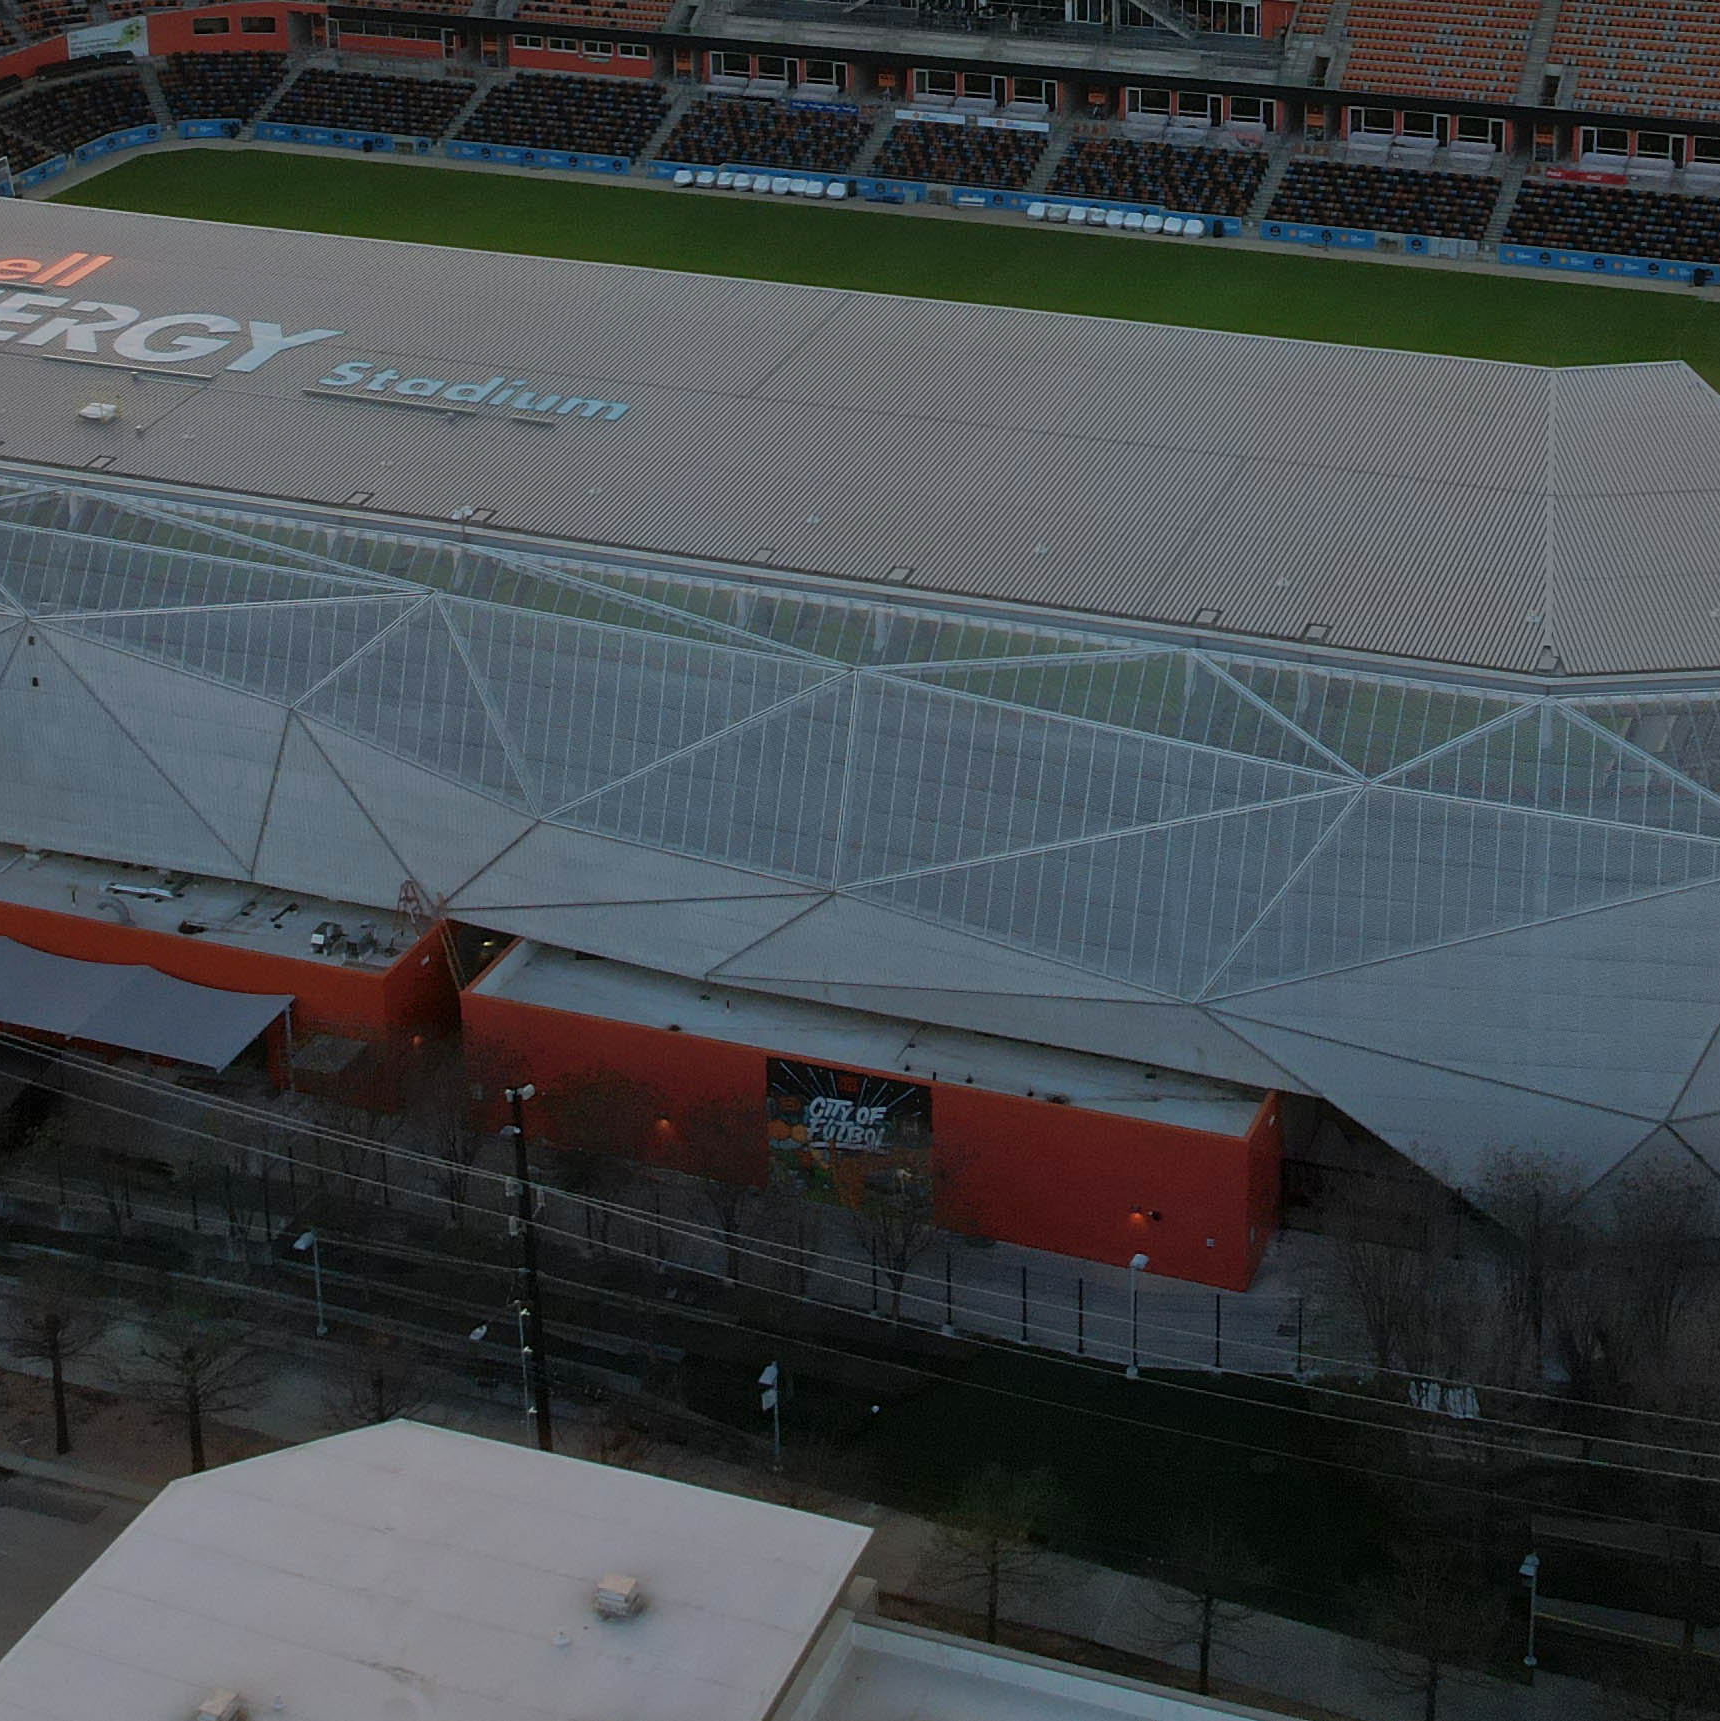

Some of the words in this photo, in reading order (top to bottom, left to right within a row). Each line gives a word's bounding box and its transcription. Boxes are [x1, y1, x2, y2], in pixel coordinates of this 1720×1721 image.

[319, 361, 629, 421] Stadium
[808, 1095, 856, 1122] CITY
[856, 1105, 888, 1125] OF
